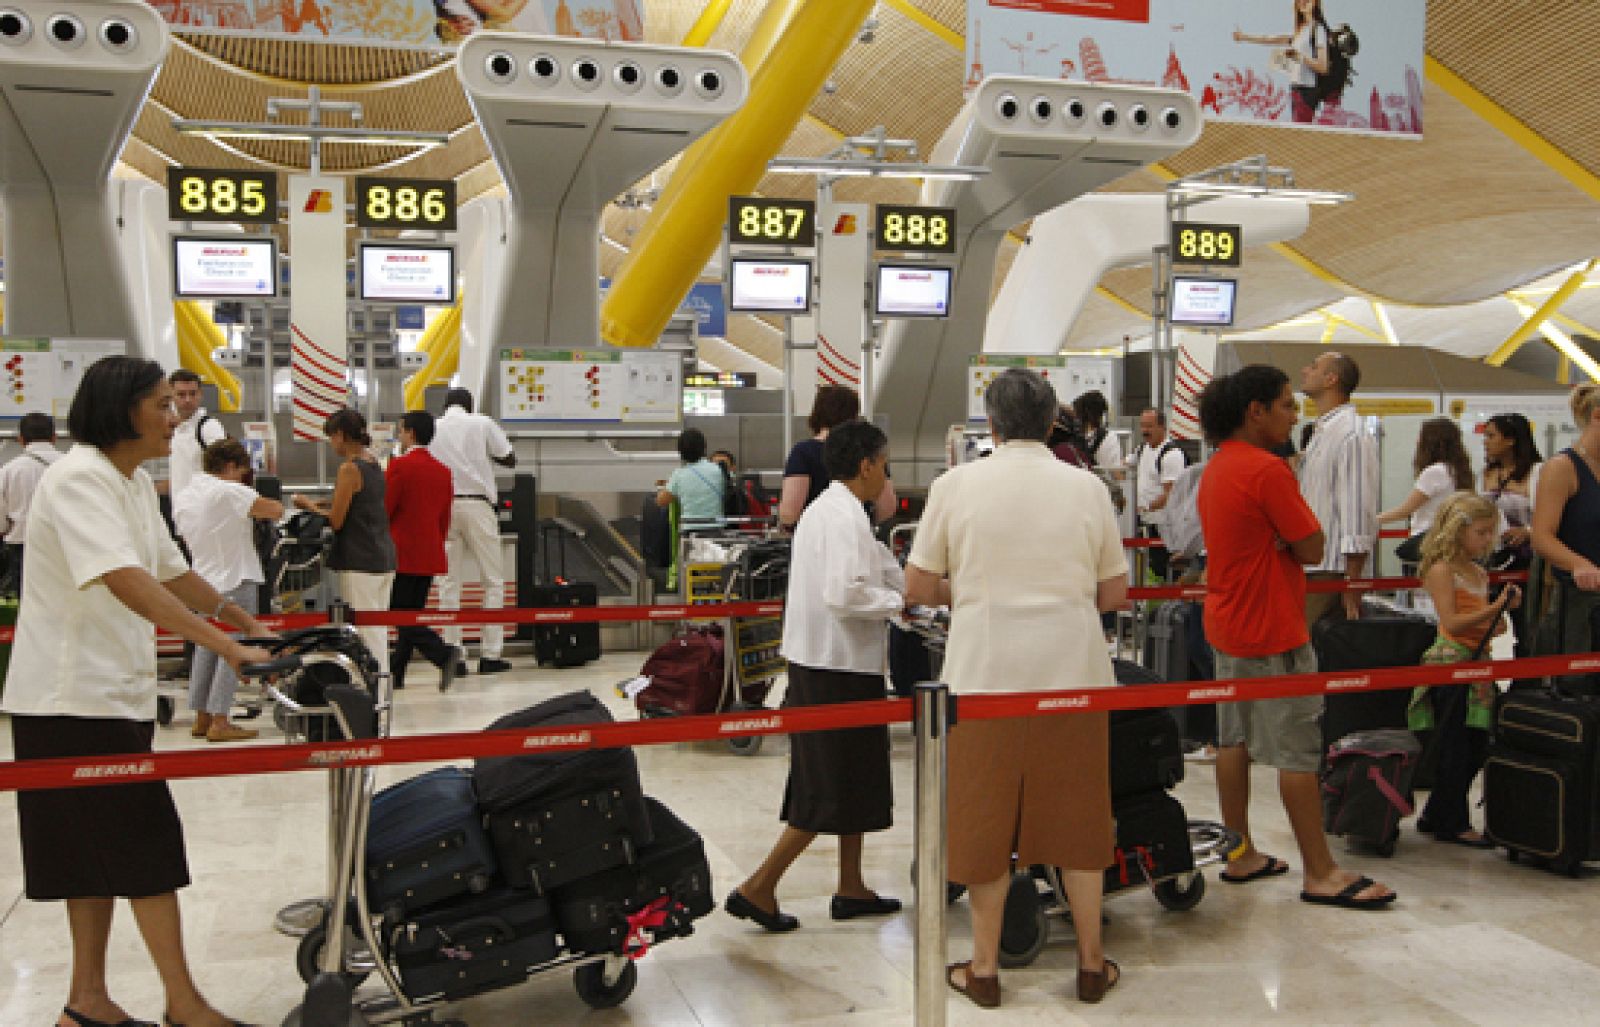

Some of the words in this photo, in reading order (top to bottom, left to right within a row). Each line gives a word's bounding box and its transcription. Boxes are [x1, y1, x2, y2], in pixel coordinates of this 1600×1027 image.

[179, 176, 266, 216] 885
[366, 186, 447, 222] 886
[739, 206, 807, 240] 887
[884, 213, 950, 246] 888
[1180, 229, 1235, 260] 889
[74, 762, 142, 779] IBERIA
